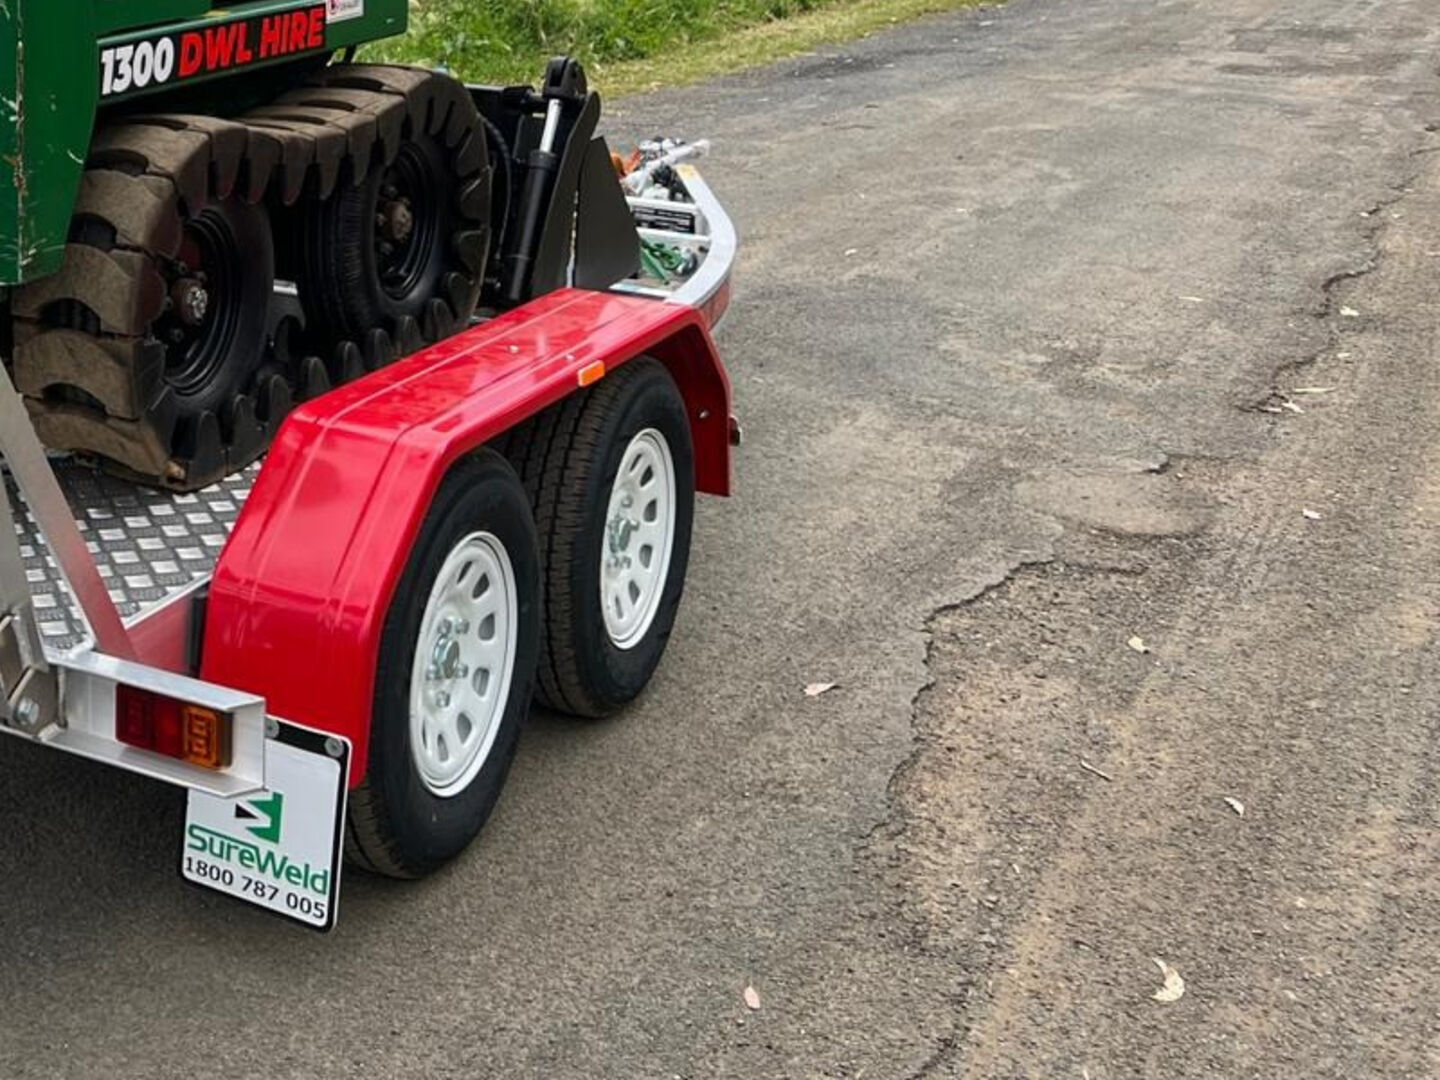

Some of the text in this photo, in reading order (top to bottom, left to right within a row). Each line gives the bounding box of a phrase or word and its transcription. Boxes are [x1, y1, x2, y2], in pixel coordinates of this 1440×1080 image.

[100, 7, 327, 95] 1300 DWL HIRE
[186, 857, 325, 919] 1800 787 005
[188, 824, 328, 895] SureWeld
